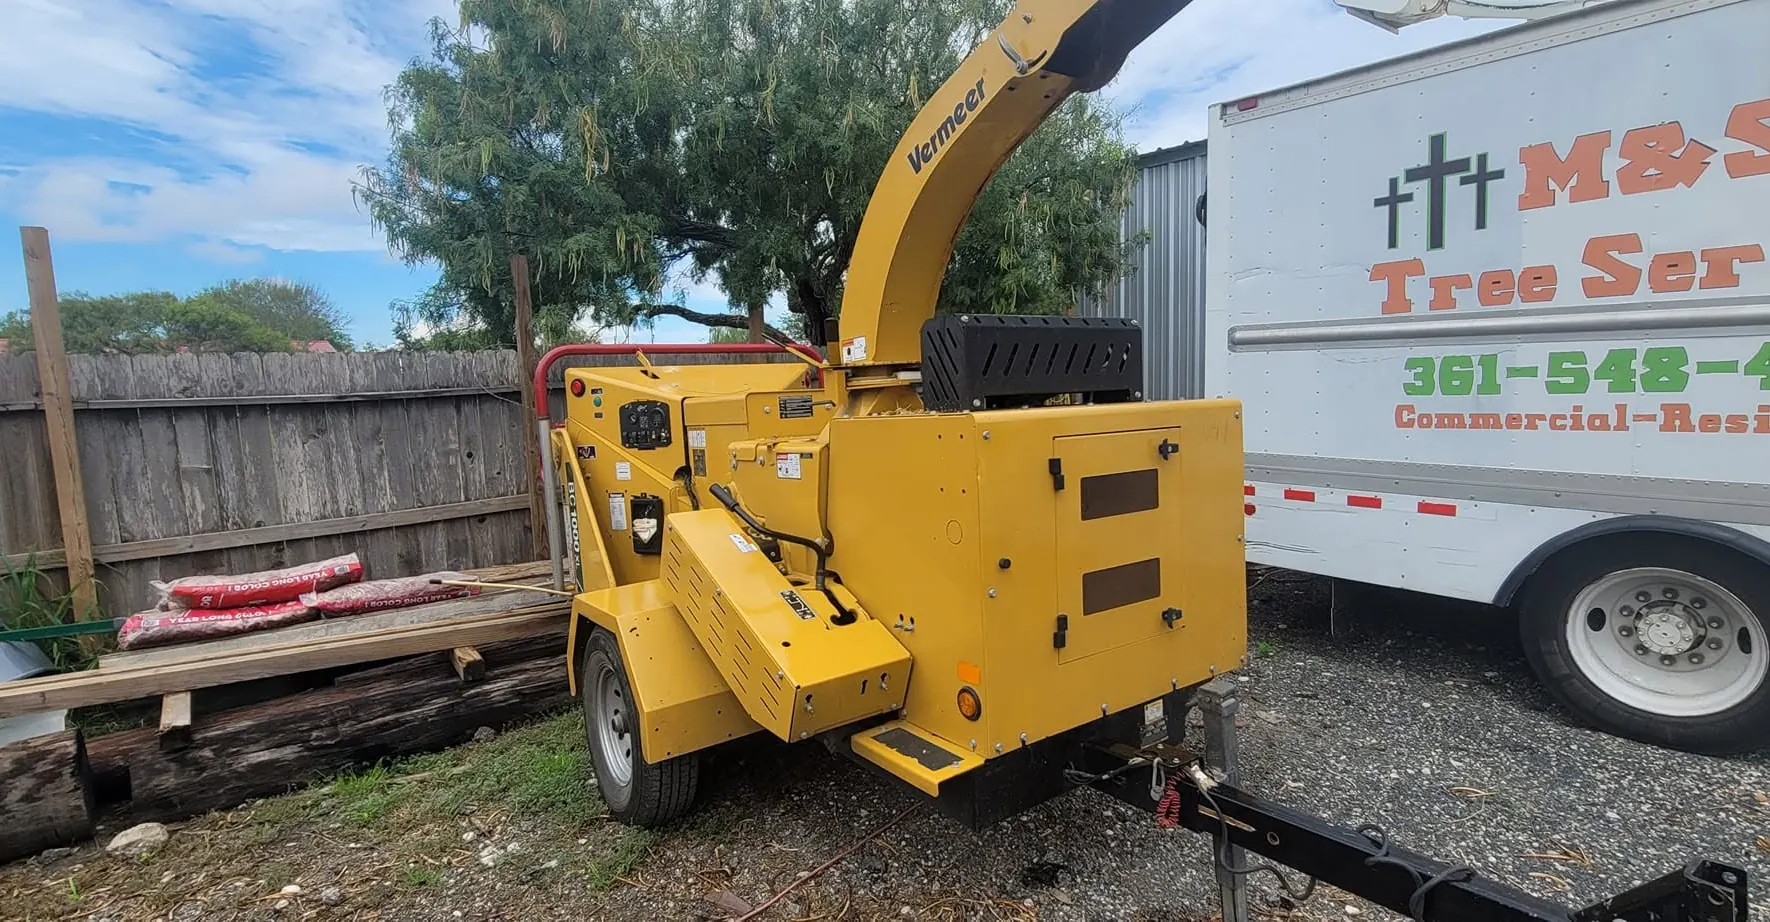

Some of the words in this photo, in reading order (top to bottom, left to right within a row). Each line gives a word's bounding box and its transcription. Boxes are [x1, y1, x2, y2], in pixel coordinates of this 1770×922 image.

[907, 76, 985, 175] Vermeer
[1369, 257, 1558, 315] Tree
[1581, 232, 1765, 299] Ser
[568, 481, 576, 506] BC
[570, 508, 580, 552] 1000
[271, 575, 301, 586] LONG
[302, 570, 328, 582] YEAR
[402, 596, 428, 605] LONG
[169, 615, 199, 624] YEAR
[202, 613, 233, 622] LONG
